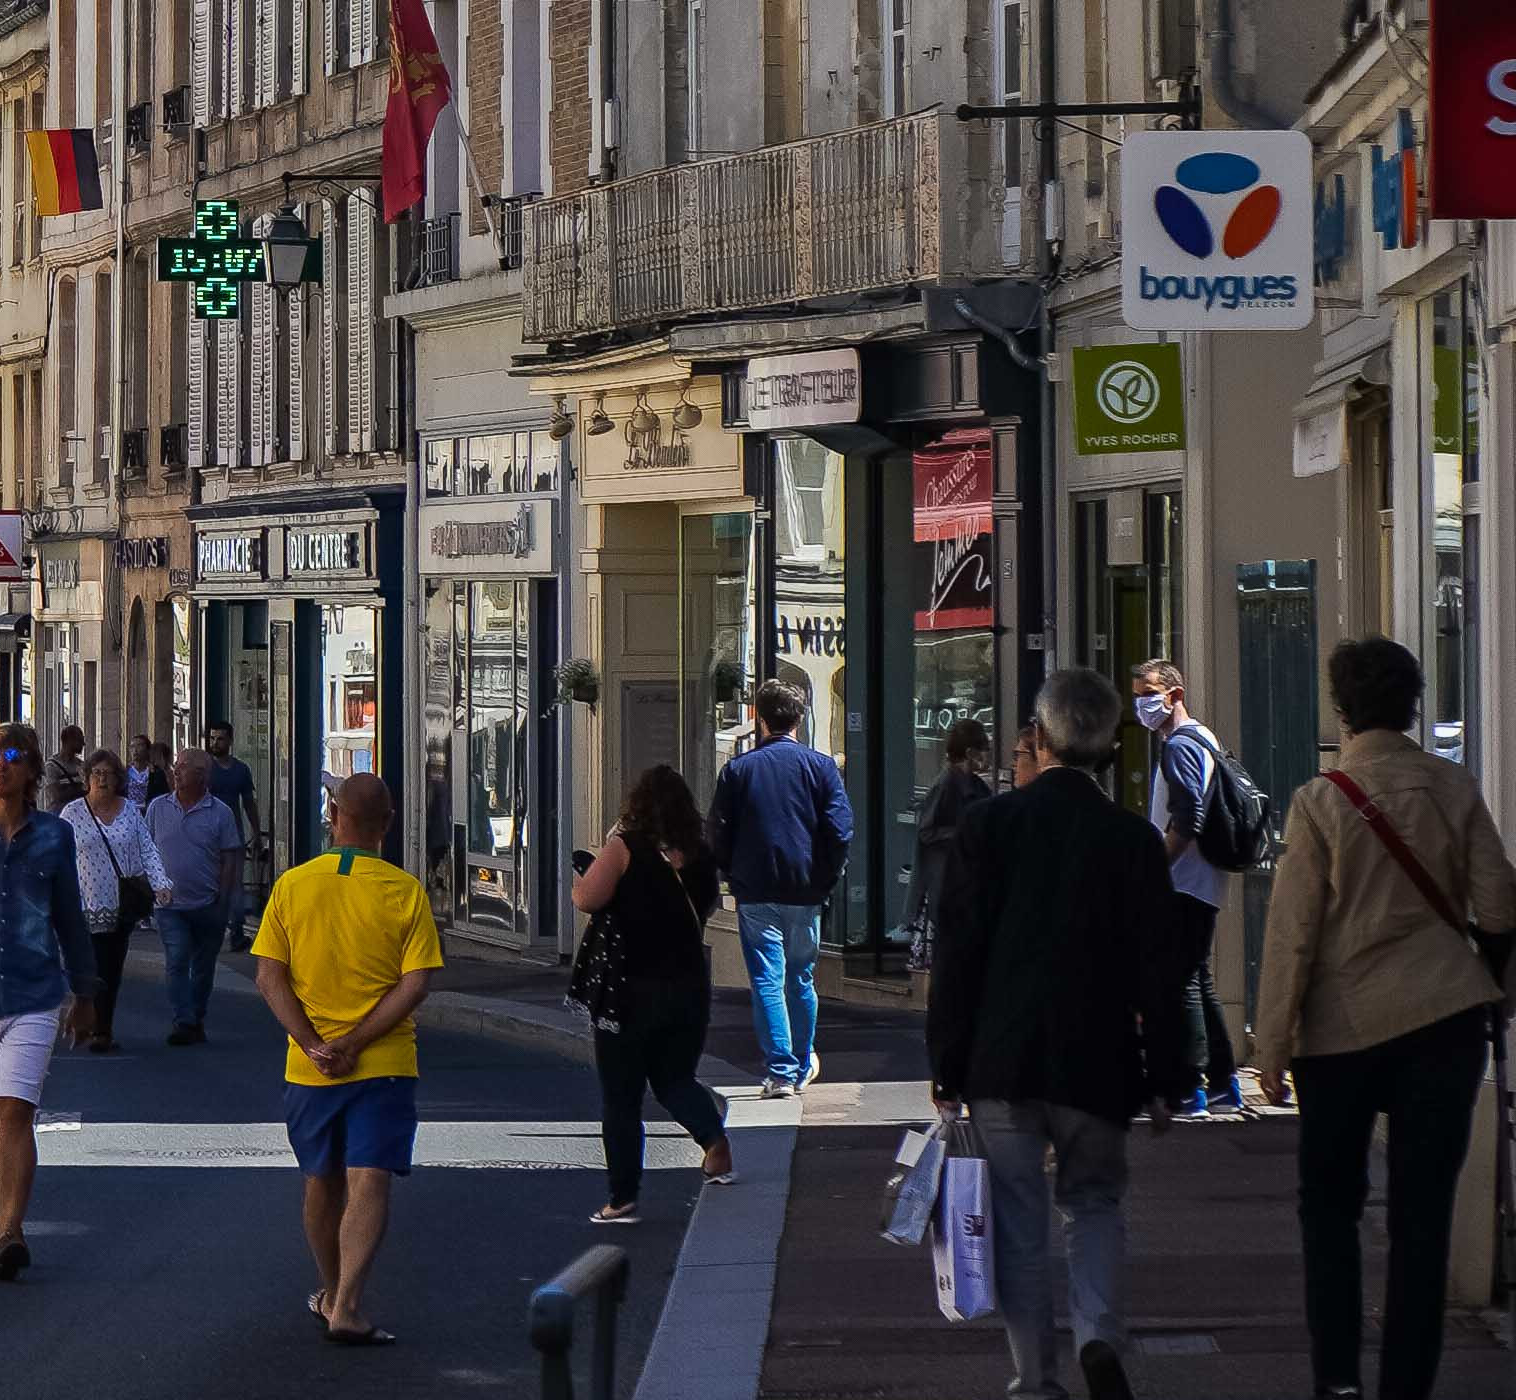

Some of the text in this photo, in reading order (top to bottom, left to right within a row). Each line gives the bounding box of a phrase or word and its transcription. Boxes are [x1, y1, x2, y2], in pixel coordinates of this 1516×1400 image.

[1140, 265, 1297, 311] bouygues
[1084, 433, 1178, 447] YVES ROCHER
[199, 538, 253, 573] PHARMACIE
[290, 531, 349, 570] DU CENTRE
